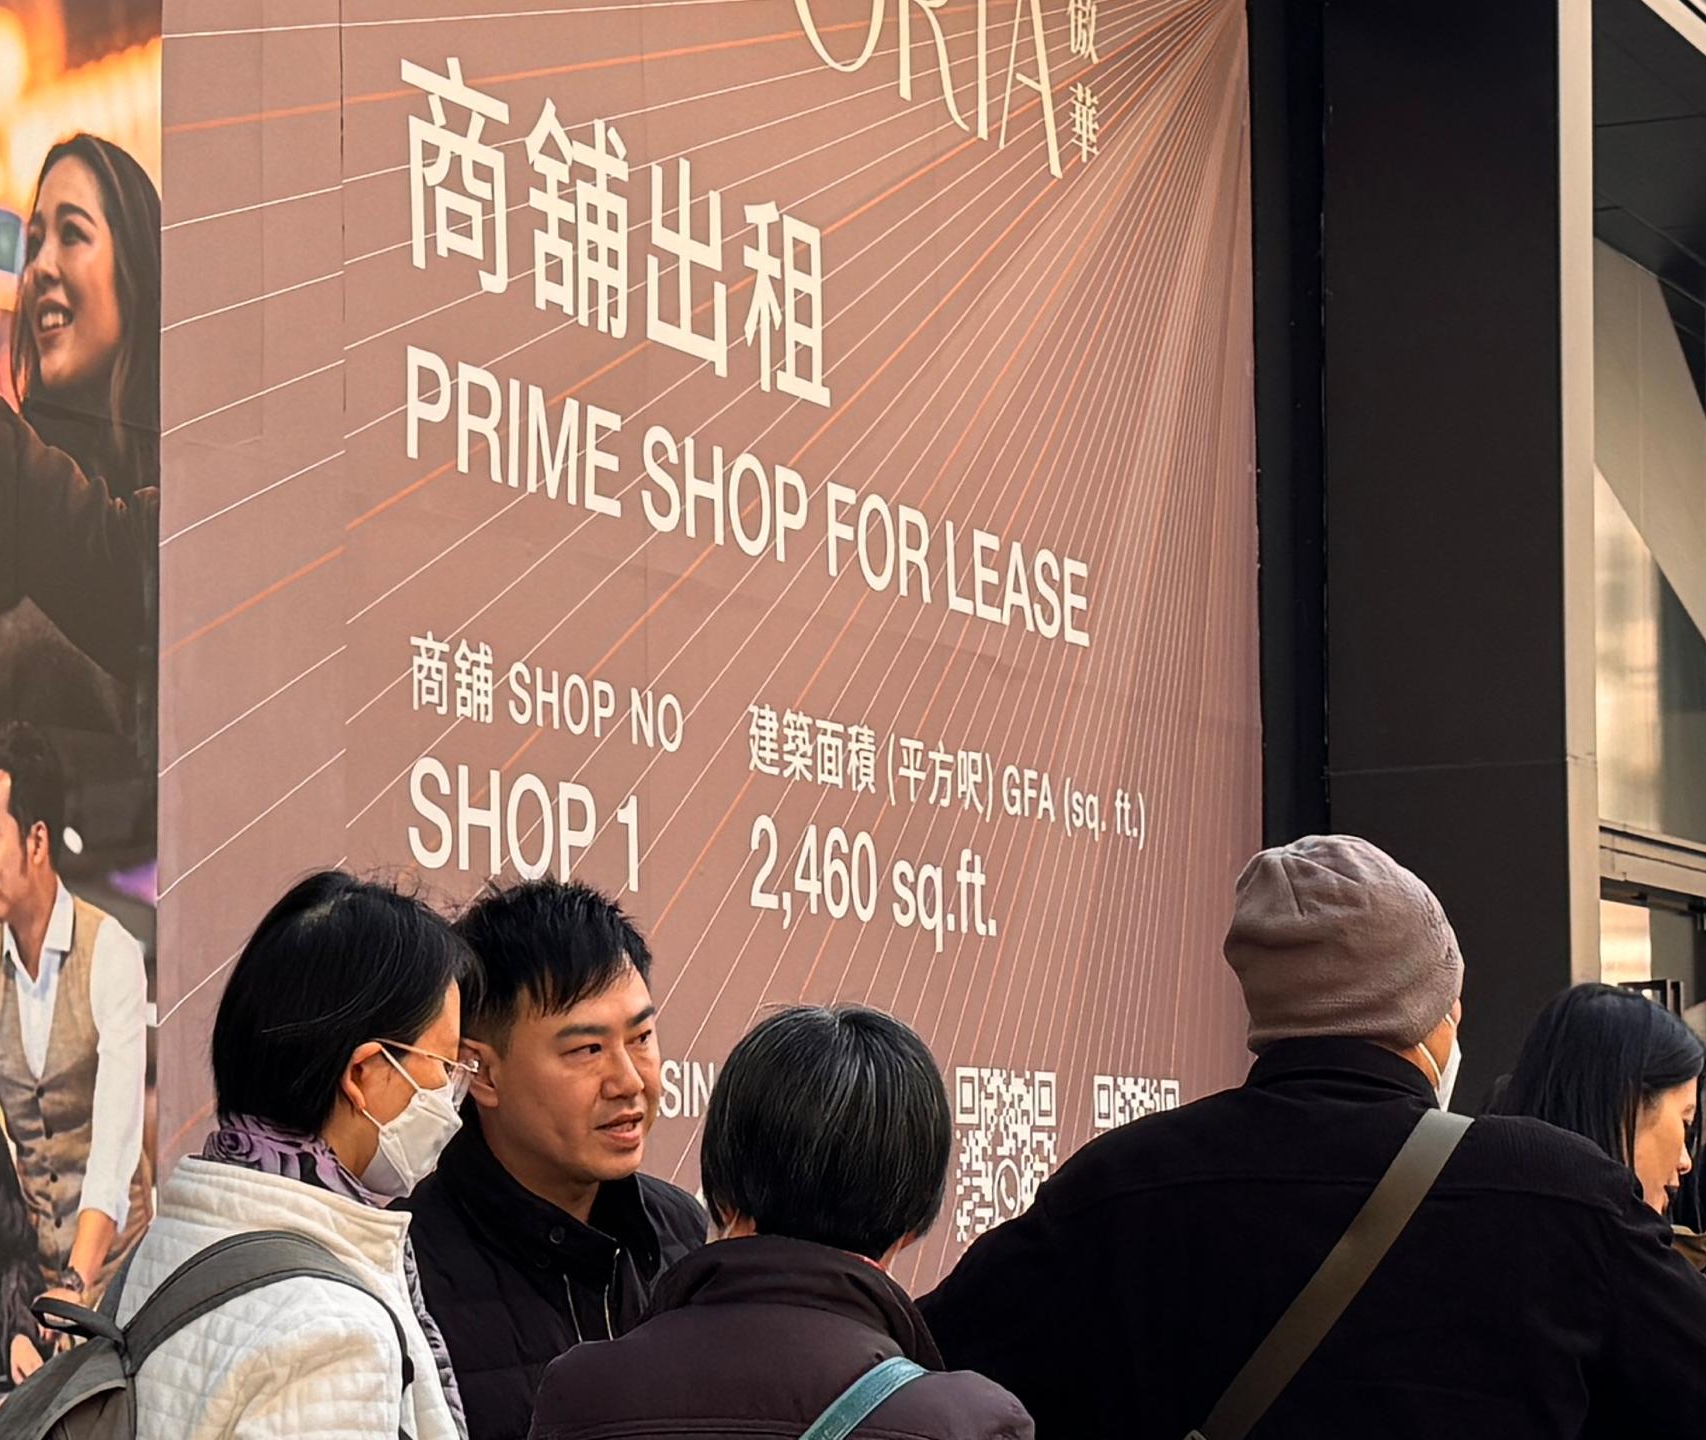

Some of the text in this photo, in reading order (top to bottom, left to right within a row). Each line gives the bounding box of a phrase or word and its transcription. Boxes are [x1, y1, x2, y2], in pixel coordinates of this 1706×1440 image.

[400, 57, 831, 409] 商舖出租
[406, 345, 1091, 648] PRIME SHOP FOR LEASE
[409, 630, 684, 752] 商舖 SHOP NO
[407, 756, 639, 892] SHOP 1
[747, 703, 1145, 850] 建築面積 (平方呎) GFA (sq. ft.)
[749, 813, 997, 953] 2,460 sq.ft.
[656, 1059, 715, 1118] SIN
